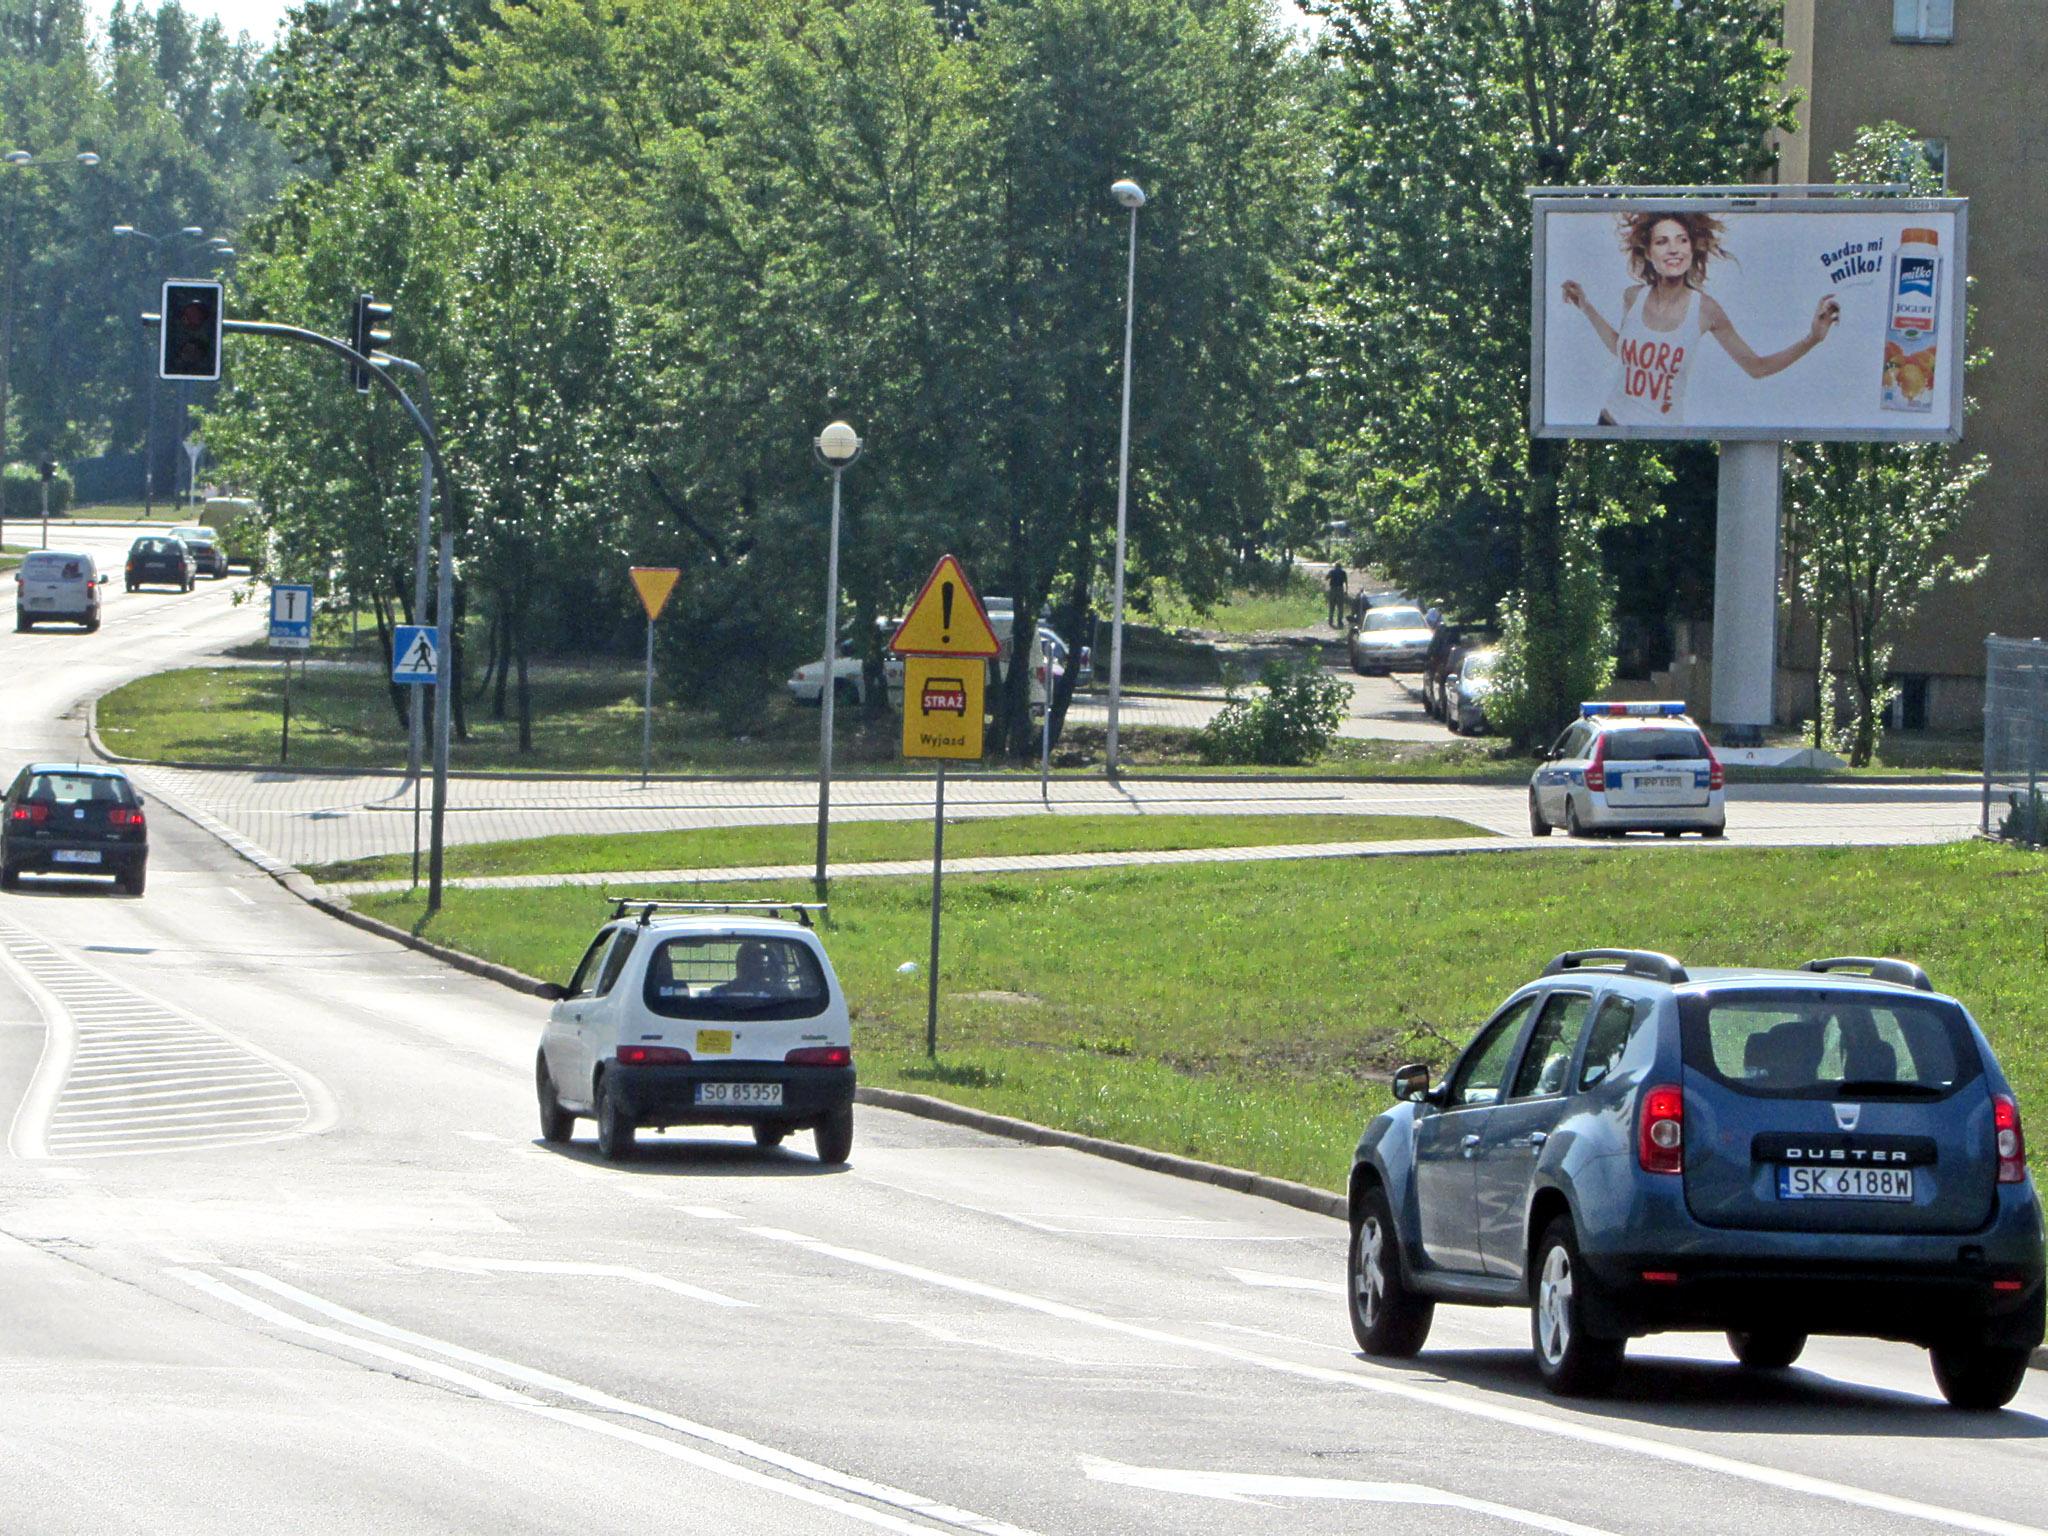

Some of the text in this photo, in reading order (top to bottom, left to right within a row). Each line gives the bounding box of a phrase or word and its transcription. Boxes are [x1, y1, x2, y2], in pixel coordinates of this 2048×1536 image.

[1820, 237, 1883, 267] Bardzo mi
[1830, 256, 1883, 284] milko!
[1901, 265, 1932, 281] milko
[924, 693, 963, 707] STRAŻ
[921, 734, 965, 747] Wyjazd
[704, 1084, 780, 1100] SO 85359
[1787, 1148, 1906, 1161] DUSTER
[1794, 1168, 1909, 1195] SK 6188W
